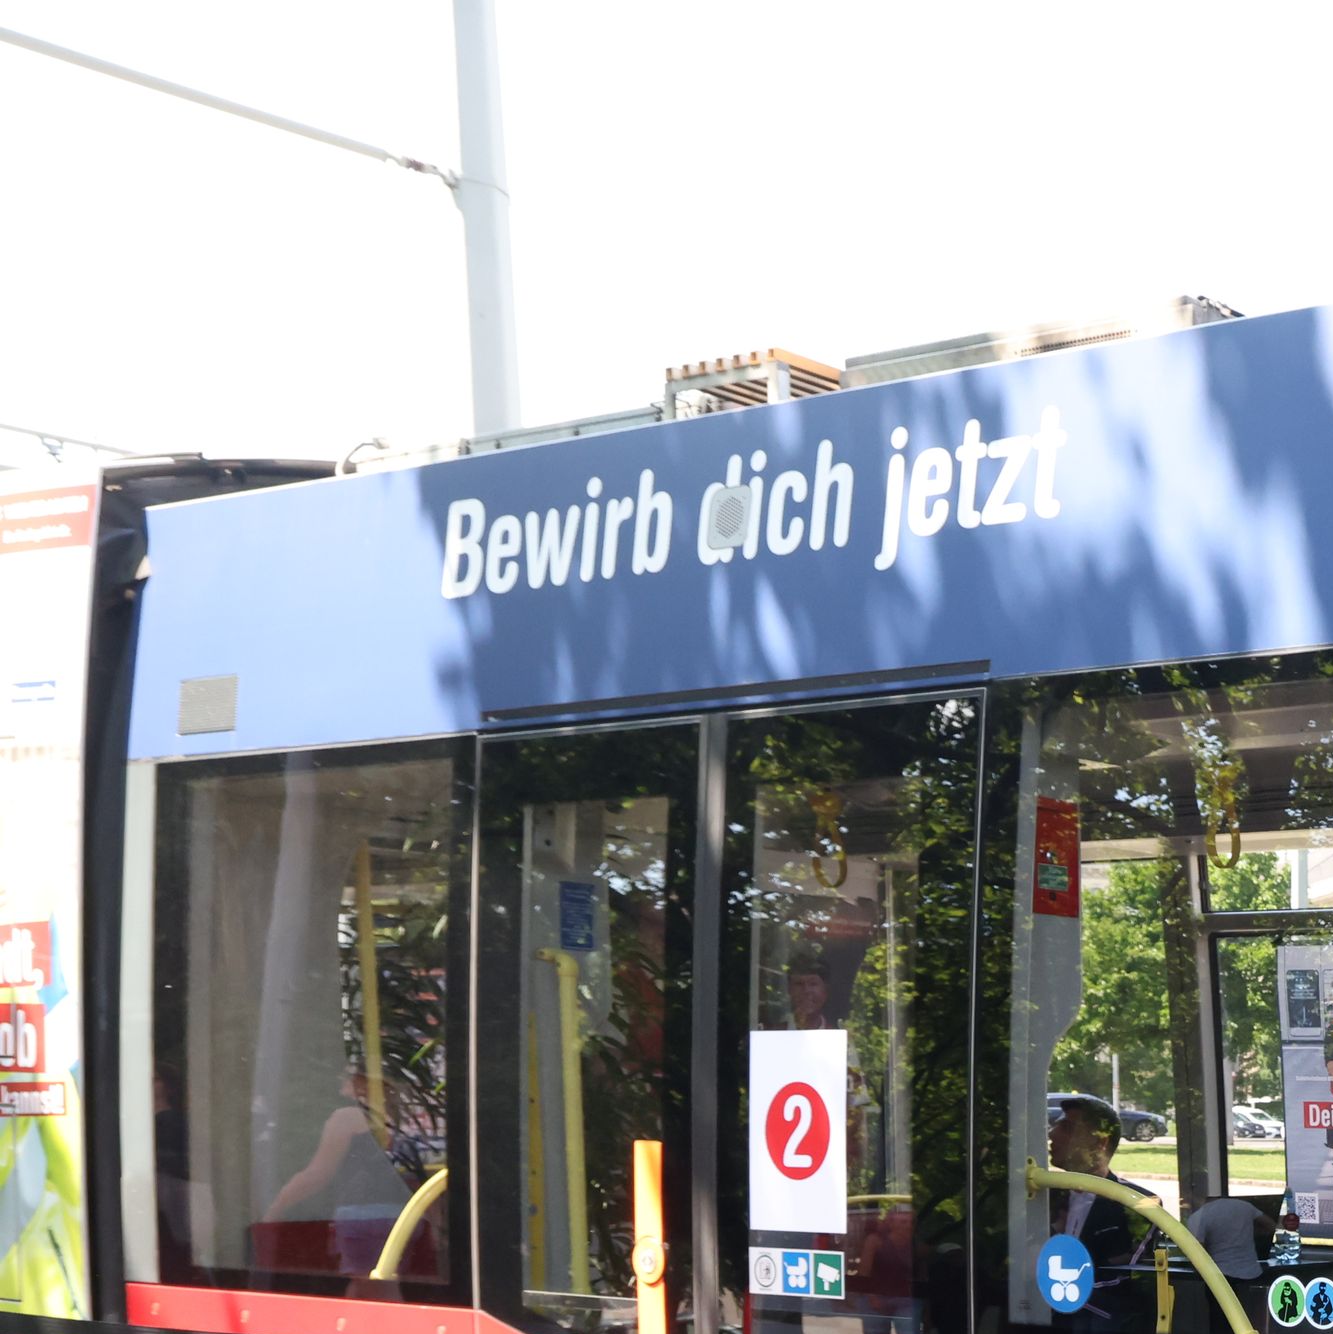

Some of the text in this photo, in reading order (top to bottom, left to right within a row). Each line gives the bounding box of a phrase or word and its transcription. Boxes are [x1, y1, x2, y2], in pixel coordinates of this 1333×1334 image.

[441, 469, 672, 599] Bewirb
[874, 405, 1067, 571] jetzt
[783, 1094, 813, 1169] 2
